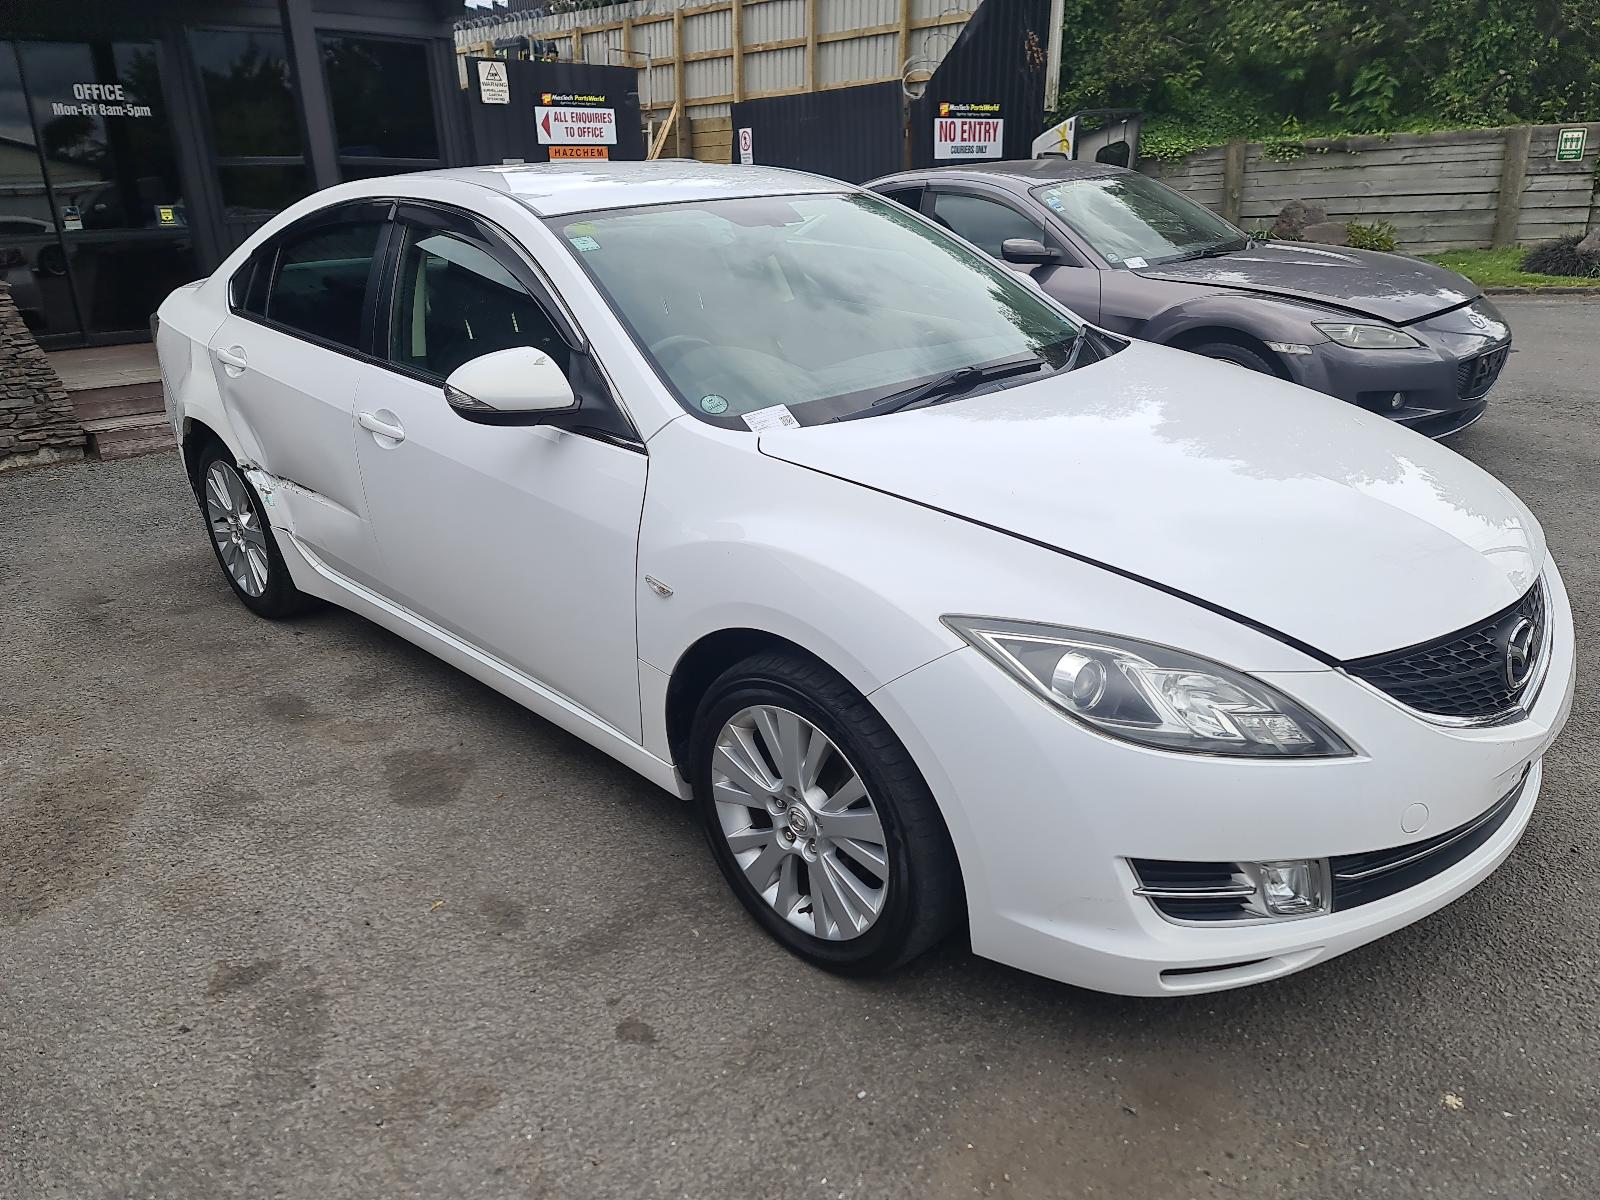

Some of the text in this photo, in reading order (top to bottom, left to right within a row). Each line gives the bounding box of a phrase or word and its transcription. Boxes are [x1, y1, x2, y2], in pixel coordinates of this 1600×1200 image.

[73, 83, 125, 101] OFFICE
[52, 102, 152, 117] Mon-Fri 8am-5pm
[554, 112, 613, 124] ALL ENQUIRIES
[565, 127, 604, 138] TO OFFICE
[939, 121, 998, 142] NO ENTRY
[554, 148, 604, 157] HAZCHEM
[951, 145, 988, 154] COURIERS ONLY
